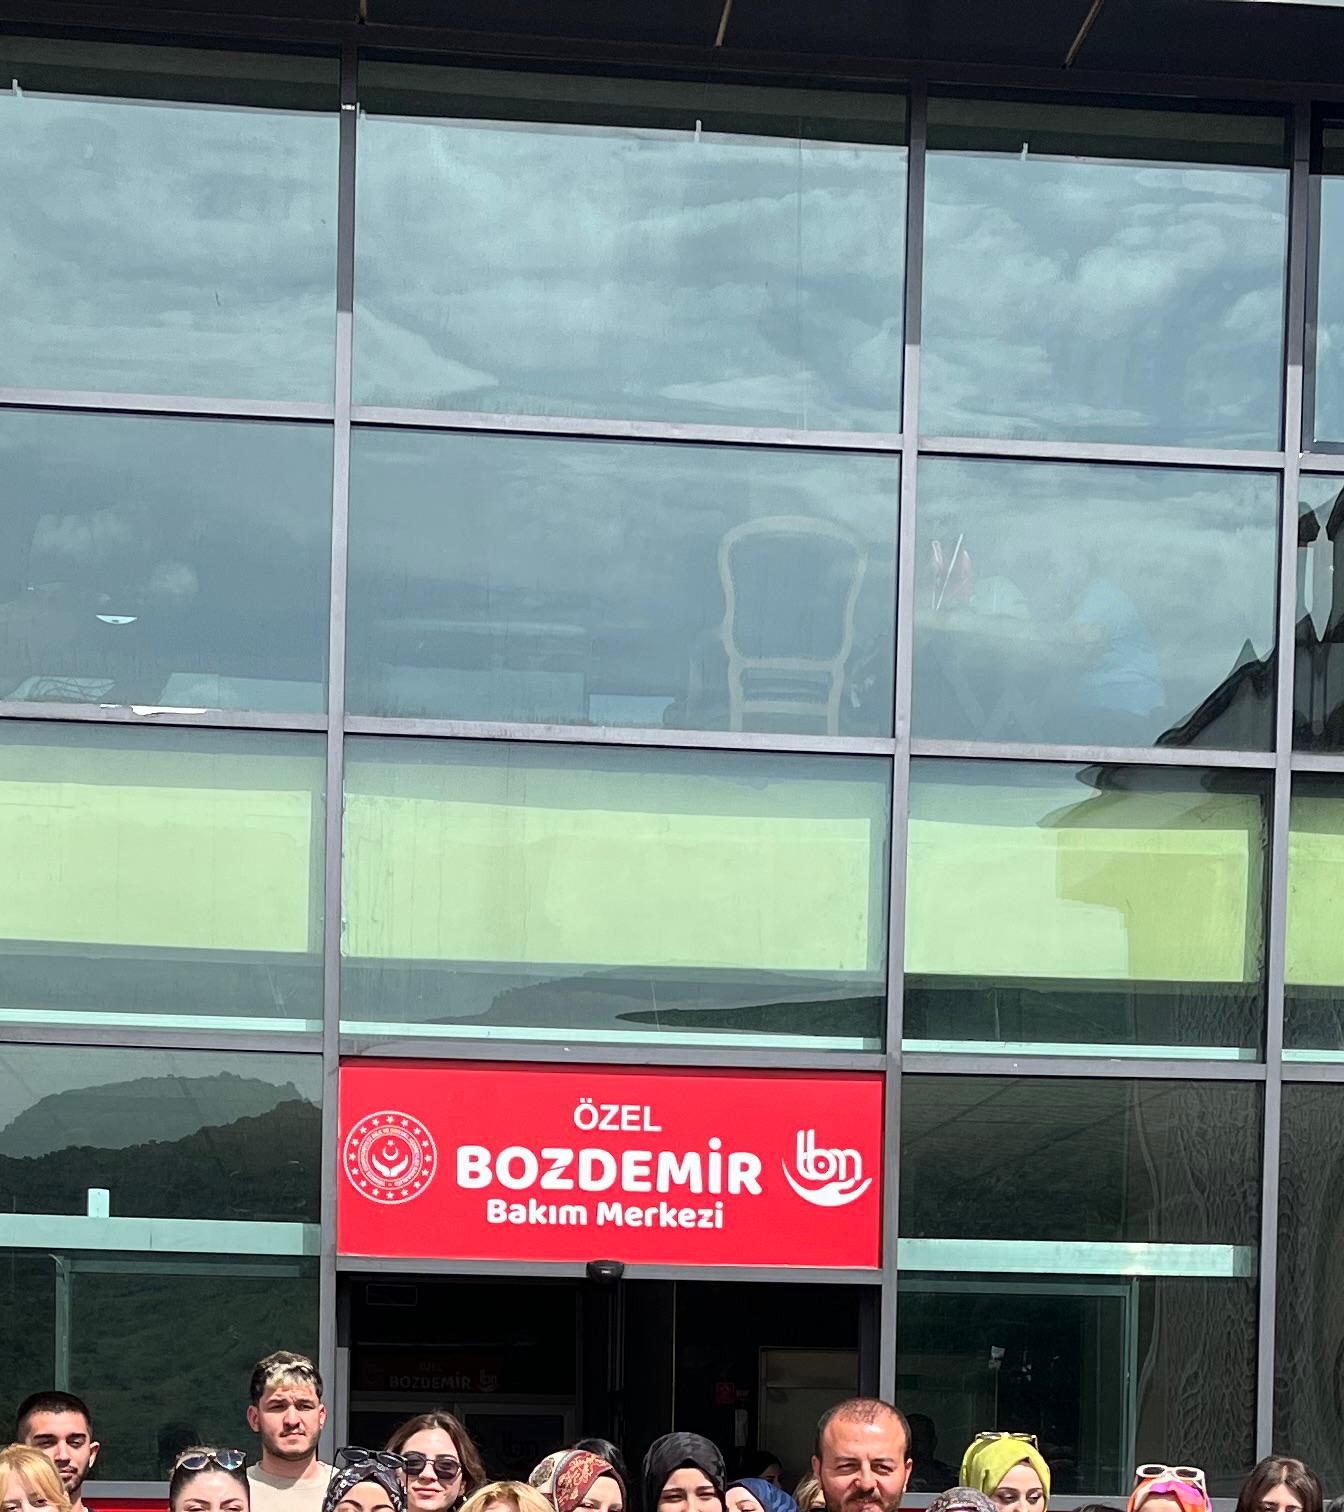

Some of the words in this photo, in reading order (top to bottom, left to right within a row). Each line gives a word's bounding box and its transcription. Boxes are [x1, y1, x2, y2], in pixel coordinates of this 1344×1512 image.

[573, 1097, 662, 1132] ÖZEL
[456, 1136, 763, 1195] BOZDEMİR
[486, 1198, 588, 1226] Bakım
[596, 1201, 724, 1229] Merkezi
